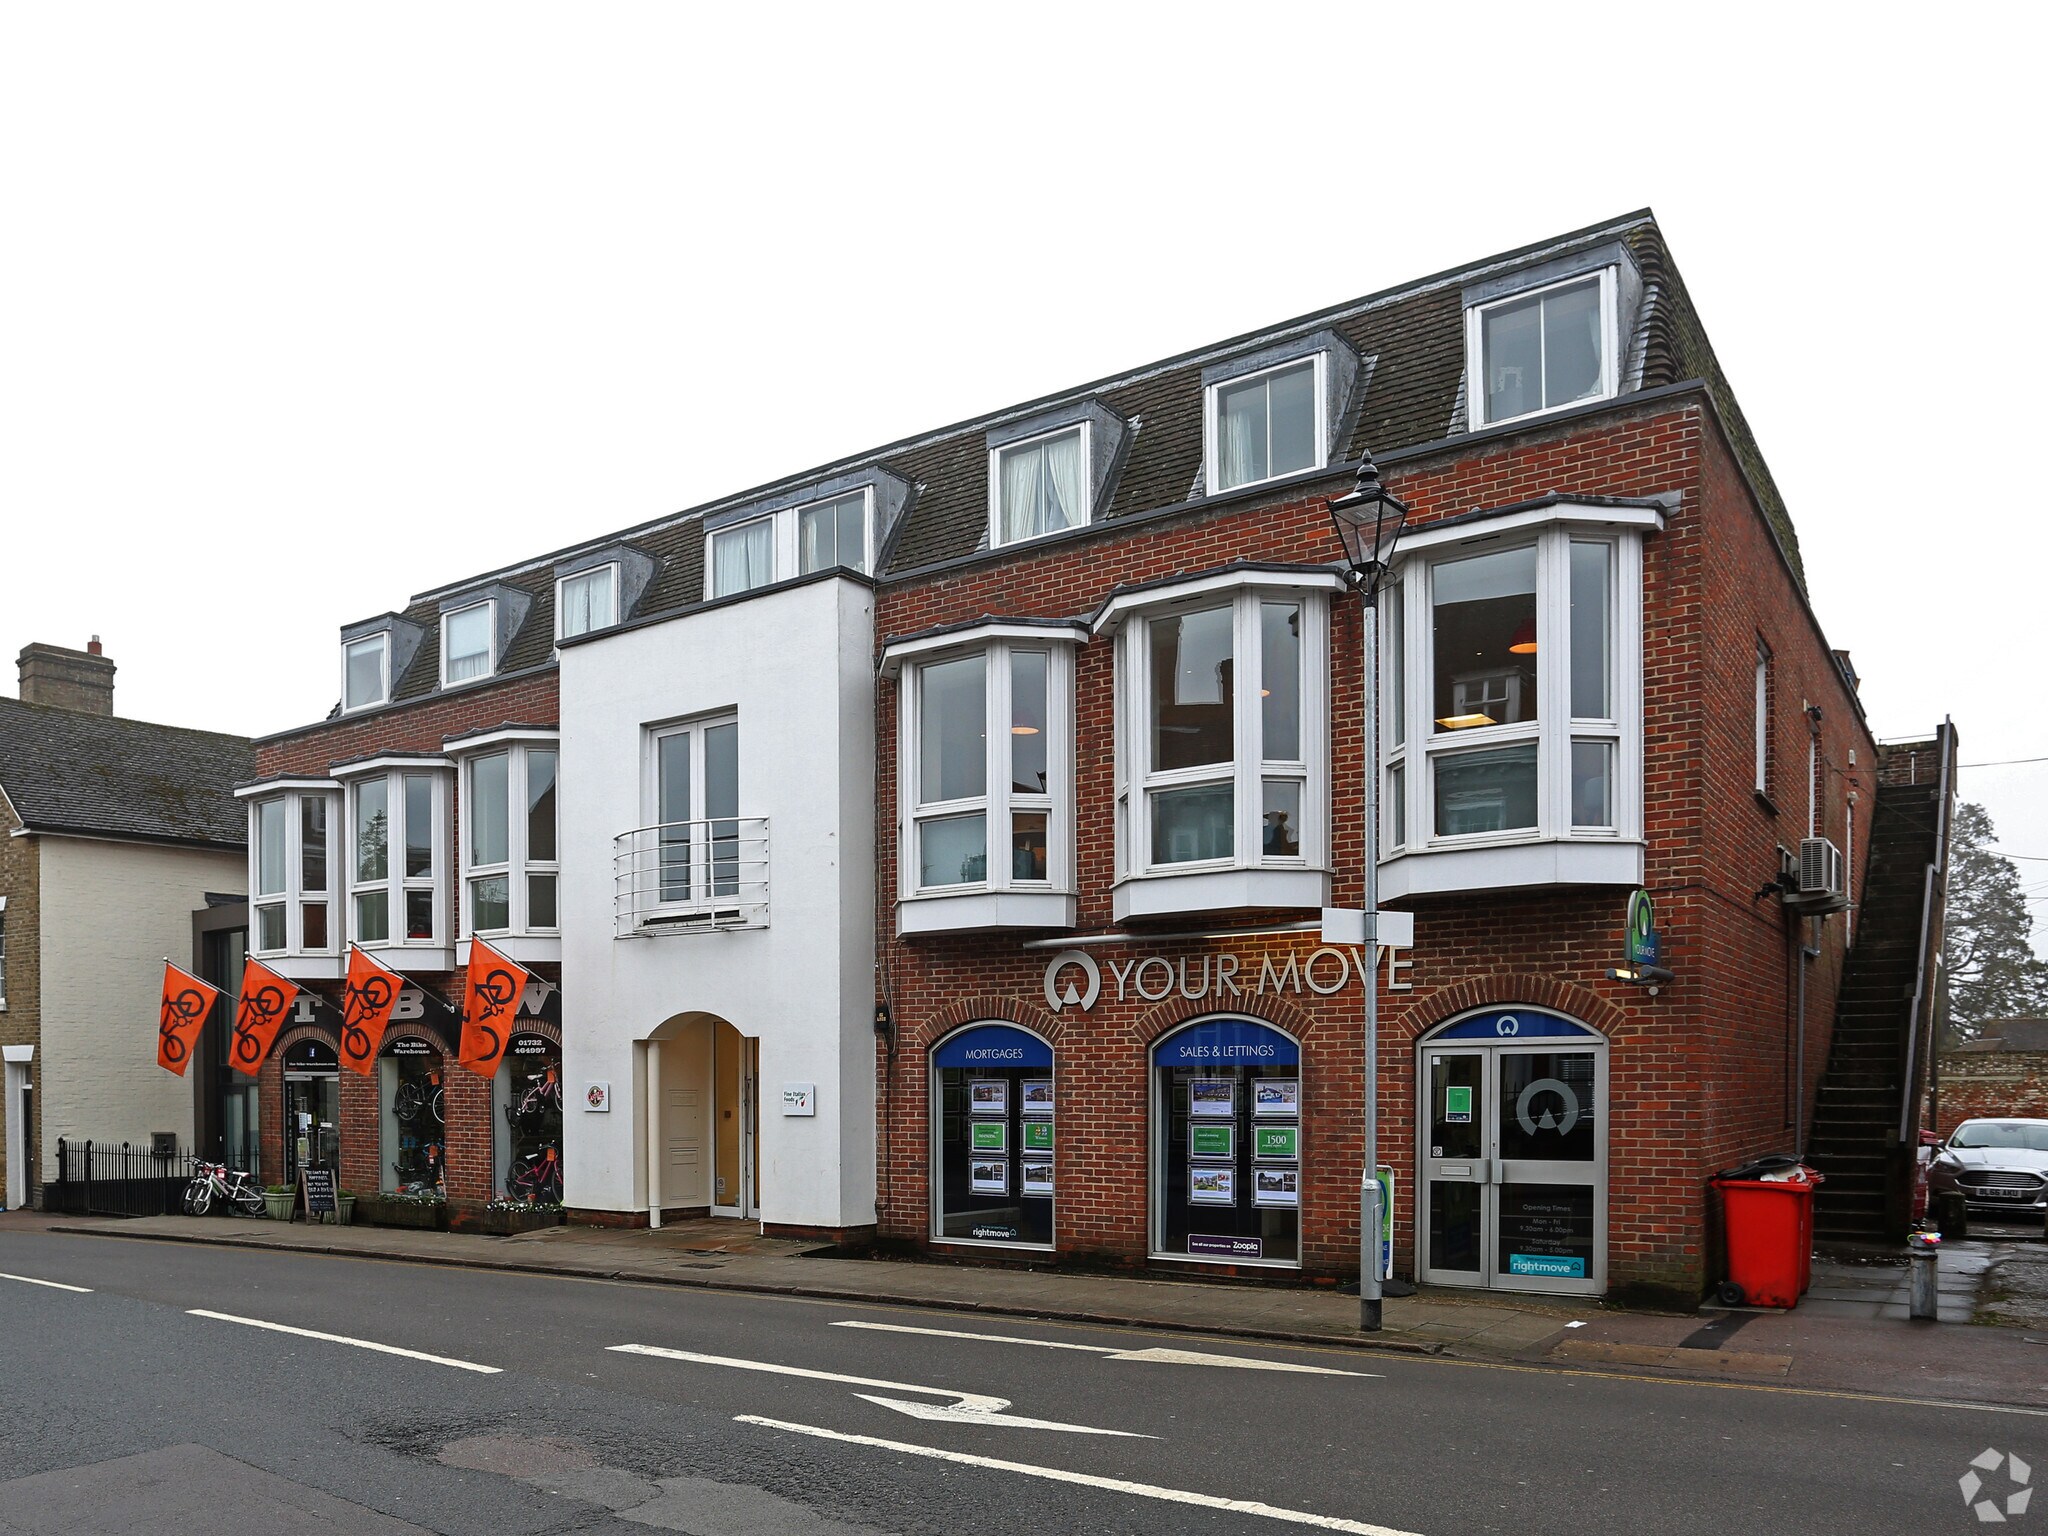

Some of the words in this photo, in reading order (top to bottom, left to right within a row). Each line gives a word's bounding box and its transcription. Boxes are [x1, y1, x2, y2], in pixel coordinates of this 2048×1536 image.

[1108, 953, 1241, 1002] YOUR
[1257, 945, 1413, 996] MOVE
[388, 989, 425, 1020] B
[965, 1048, 1023, 1059] MORTGAGES
[1180, 1046, 1209, 1057] SALES
[1212, 1045, 1220, 1057] &
[1223, 1044, 1274, 1057] LETTINGS
[1267, 1136, 1286, 1145] 1500
[1522, 1204, 1551, 1213] Opening
[972, 1228, 1009, 1238] rightmove
[1232, 1241, 1258, 1251] Zoopla
[1532, 1238, 1561, 1246] Saturday
[1513, 1260, 1571, 1273] rightmove
